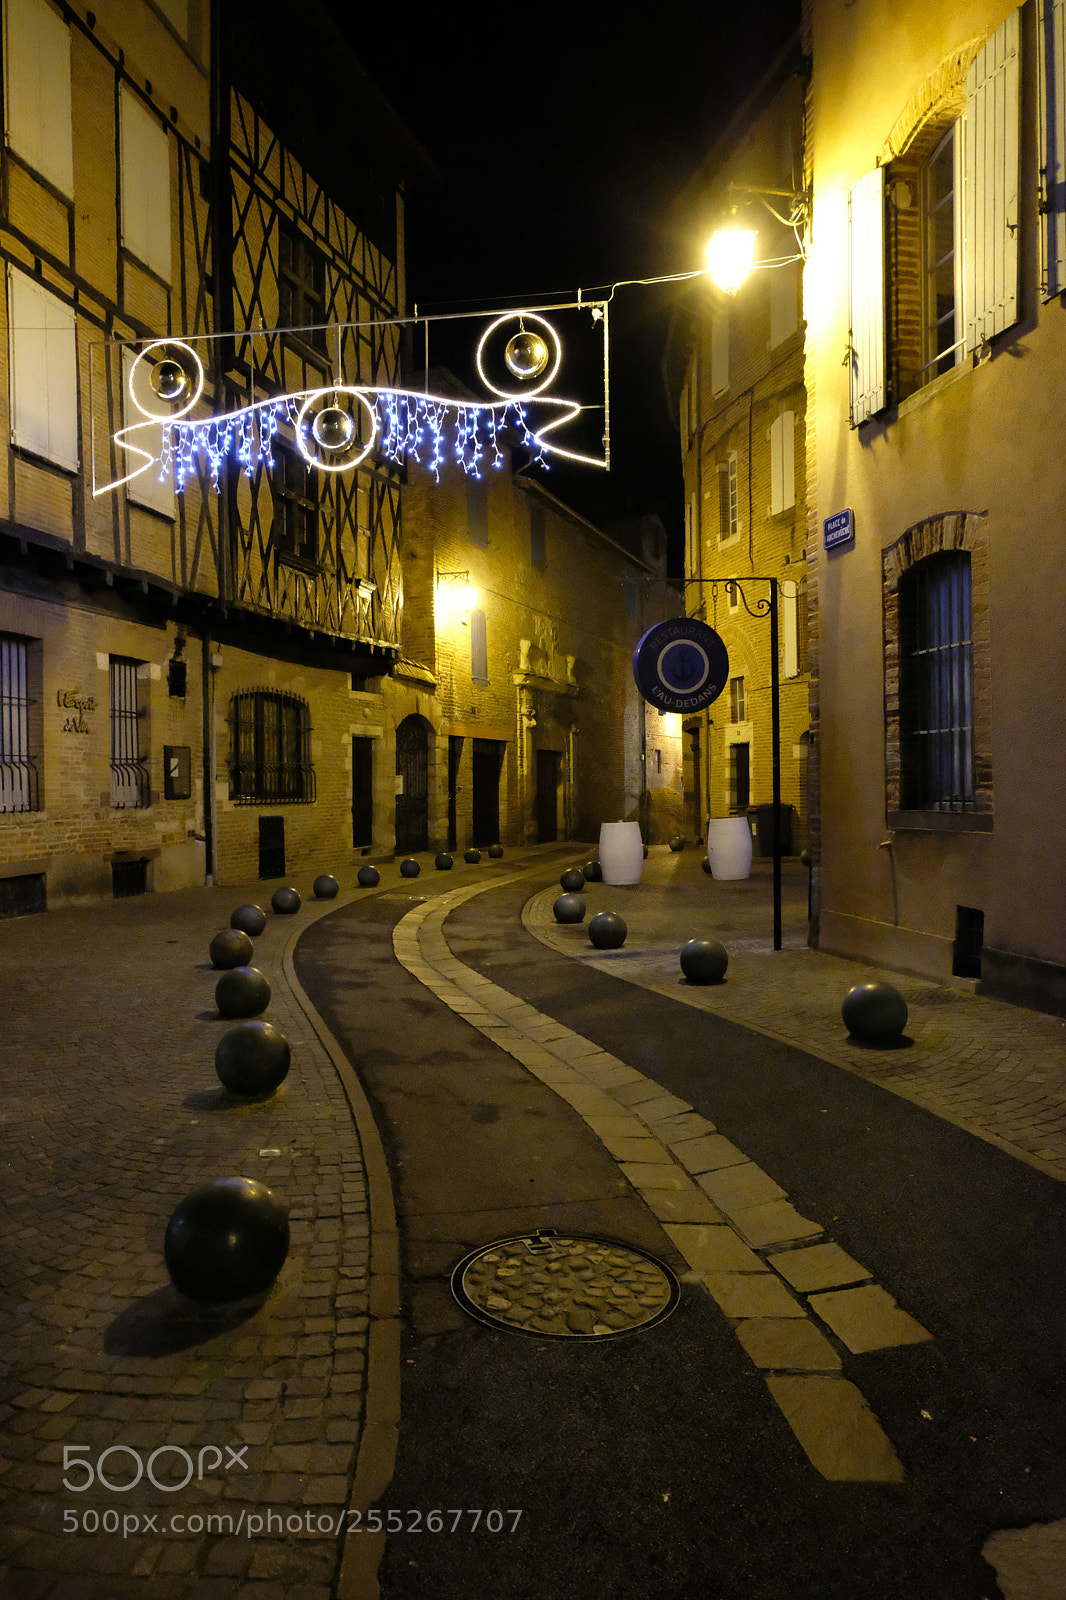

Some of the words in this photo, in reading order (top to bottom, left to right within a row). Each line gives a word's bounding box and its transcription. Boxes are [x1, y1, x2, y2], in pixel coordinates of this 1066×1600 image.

[827, 518, 841, 531] PLACE
[649, 625, 715, 648] RESTAURANT
[675, 683, 717, 708] DEDANS
